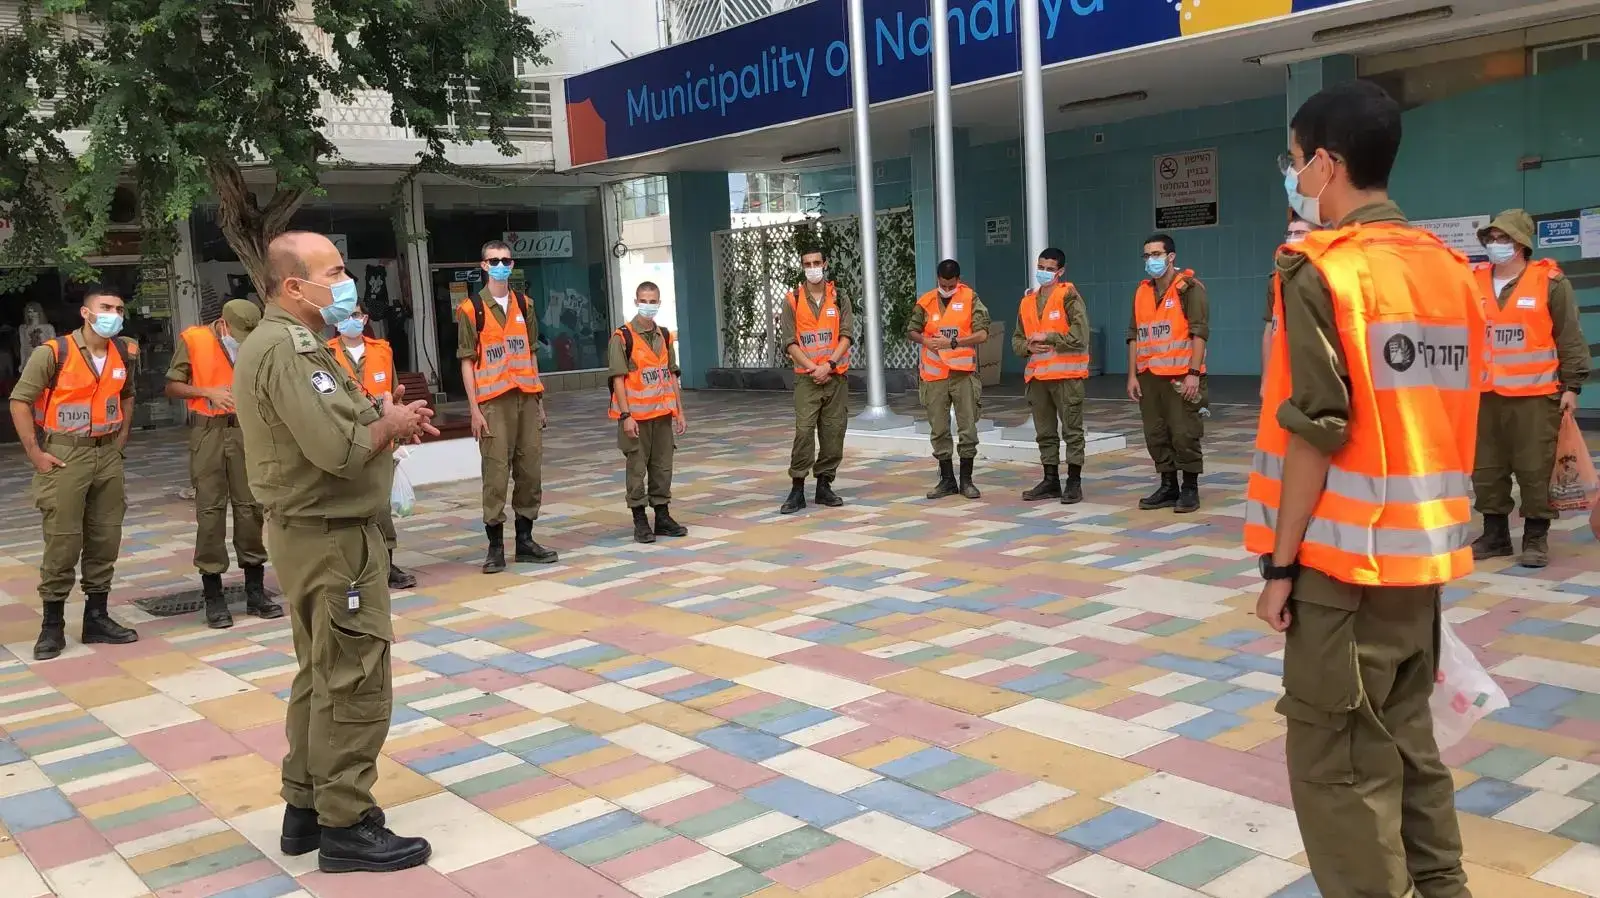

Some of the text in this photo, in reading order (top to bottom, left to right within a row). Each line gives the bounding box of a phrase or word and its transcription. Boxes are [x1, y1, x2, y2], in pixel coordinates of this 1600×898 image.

[626, 45, 815, 127] Municipality
[825, 40, 849, 77] o
[1191, 179, 1211, 189] אסור
[1546, 221, 1573, 230] הכניסה
[1548, 228, 1572, 236] מסביב
[1495, 328, 1525, 345] פיקוד
[506, 339, 525, 352] פיקוד
[58, 411, 90, 423] העורף
